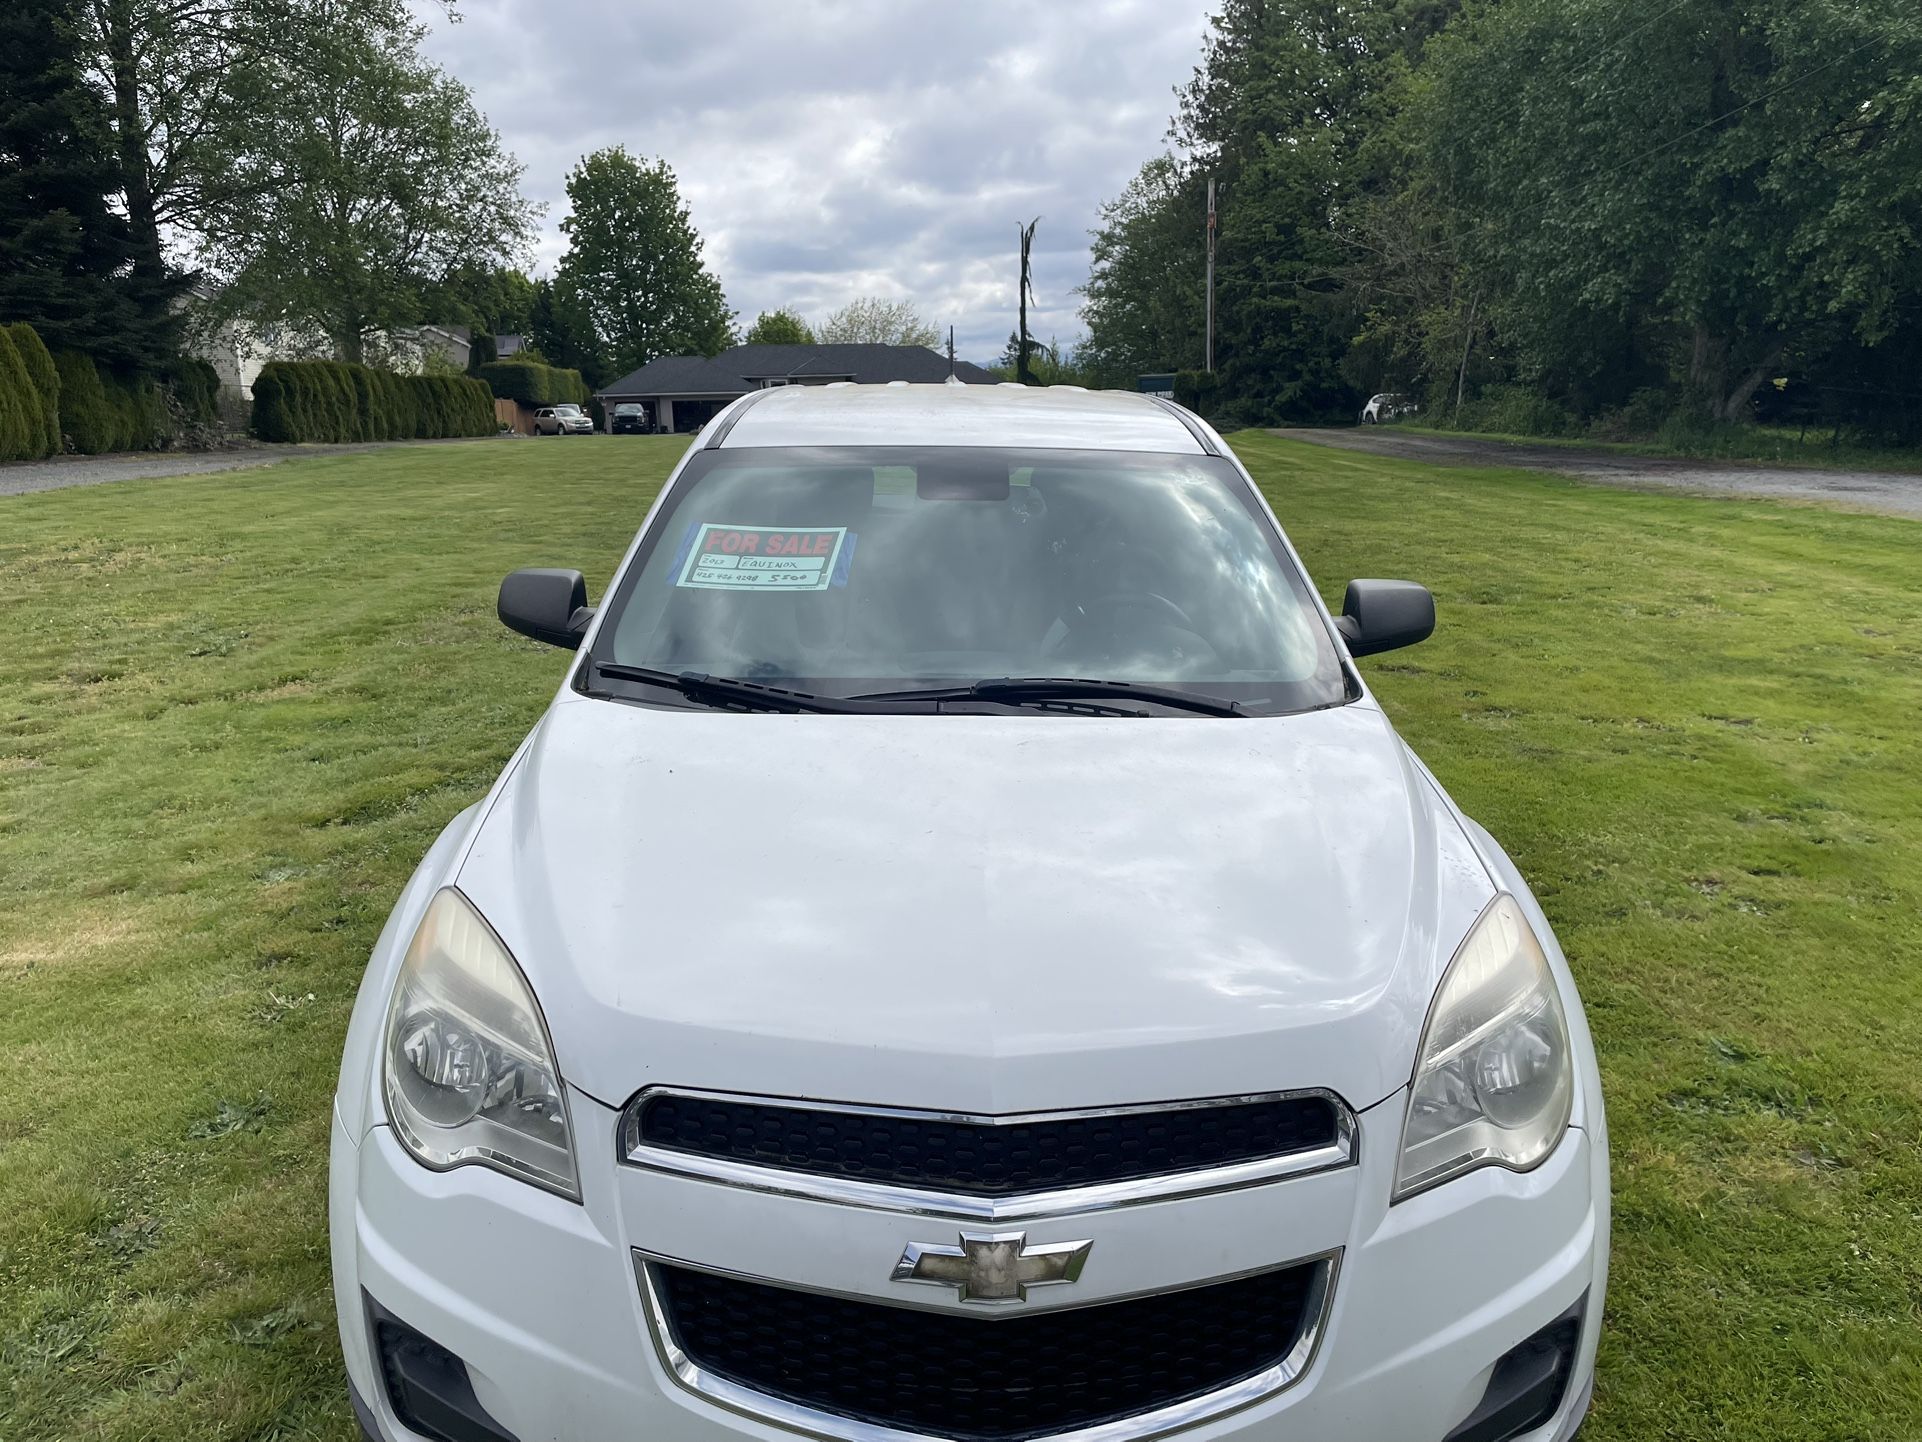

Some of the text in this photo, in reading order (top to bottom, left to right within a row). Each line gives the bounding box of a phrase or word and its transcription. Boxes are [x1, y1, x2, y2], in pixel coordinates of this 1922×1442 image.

[705, 531, 833, 555] FOR SALE
[741, 559, 798, 569] EQUINOX
[696, 571, 715, 579] 425
[768, 574, 807, 583] 5500
